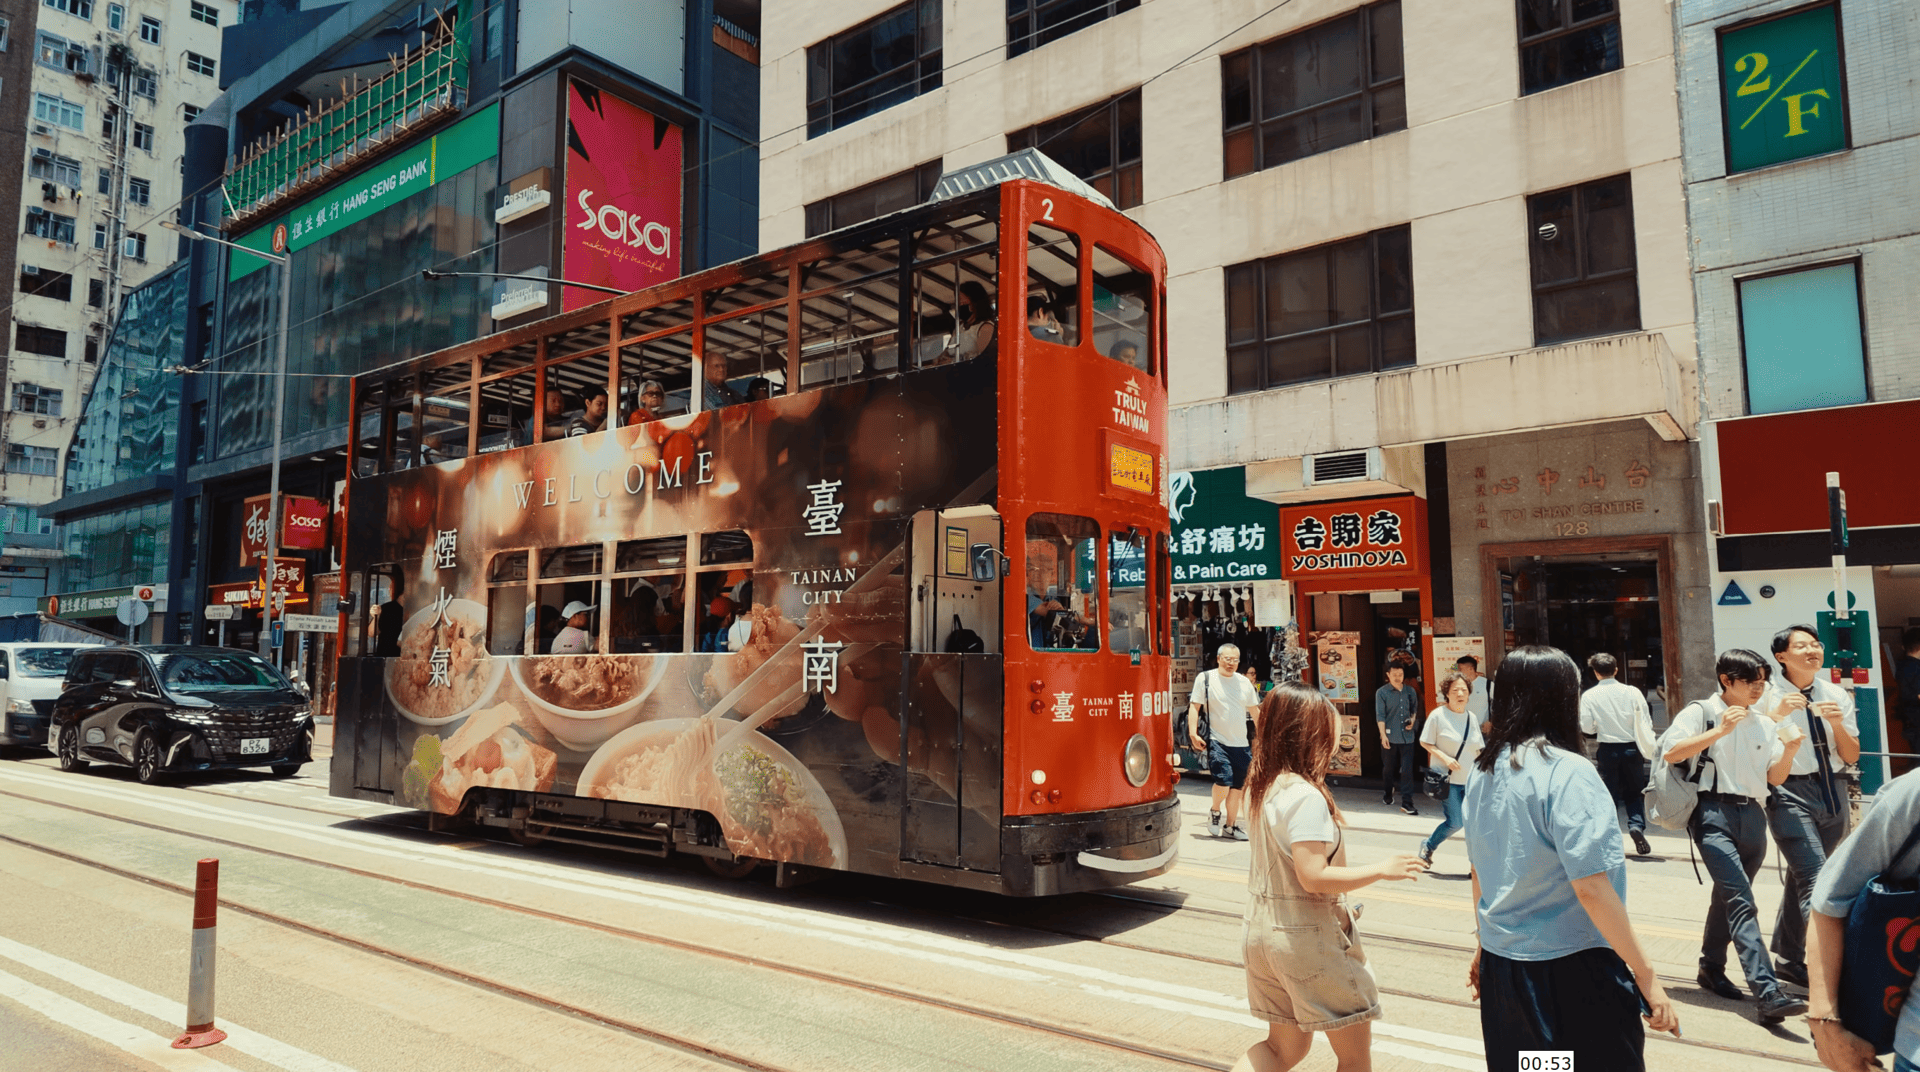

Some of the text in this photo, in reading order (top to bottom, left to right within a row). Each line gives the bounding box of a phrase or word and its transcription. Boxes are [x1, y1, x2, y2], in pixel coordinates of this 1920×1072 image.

[1734, 49, 1831, 138] 2/F
[343, 189, 368, 213] HANG
[370, 175, 396, 199] SENG
[399, 158, 427, 185] BANK
[1042, 198, 1054, 221] 2
[582, 239, 665, 273] making life beautiful
[501, 283, 532, 303] Preferred
[1115, 390, 1147, 415] TRULY
[1112, 407, 1149, 434] TAIWAN
[512, 451, 714, 510] WELCOME
[1502, 500, 1644, 521] TOI SHAN CENTRE
[1555, 521, 1589, 537] 128
[1174, 565, 1186, 580] &
[1189, 564, 1224, 579] Pain
[1227, 562, 1267, 577] Care
[1291, 550, 1407, 572] YOSHINOYA
[791, 568, 856, 584] TAINAN
[223, 590, 249, 602] SUKIYA
[803, 590, 844, 605] CITY
[428, 528, 458, 688] 煙火氣
[800, 635, 842, 694] 南
[1051, 691, 1075, 722] 臺
[1083, 698, 1113, 706] TAINAN
[1118, 691, 1134, 720] 南
[243, 745, 267, 754] 8326
